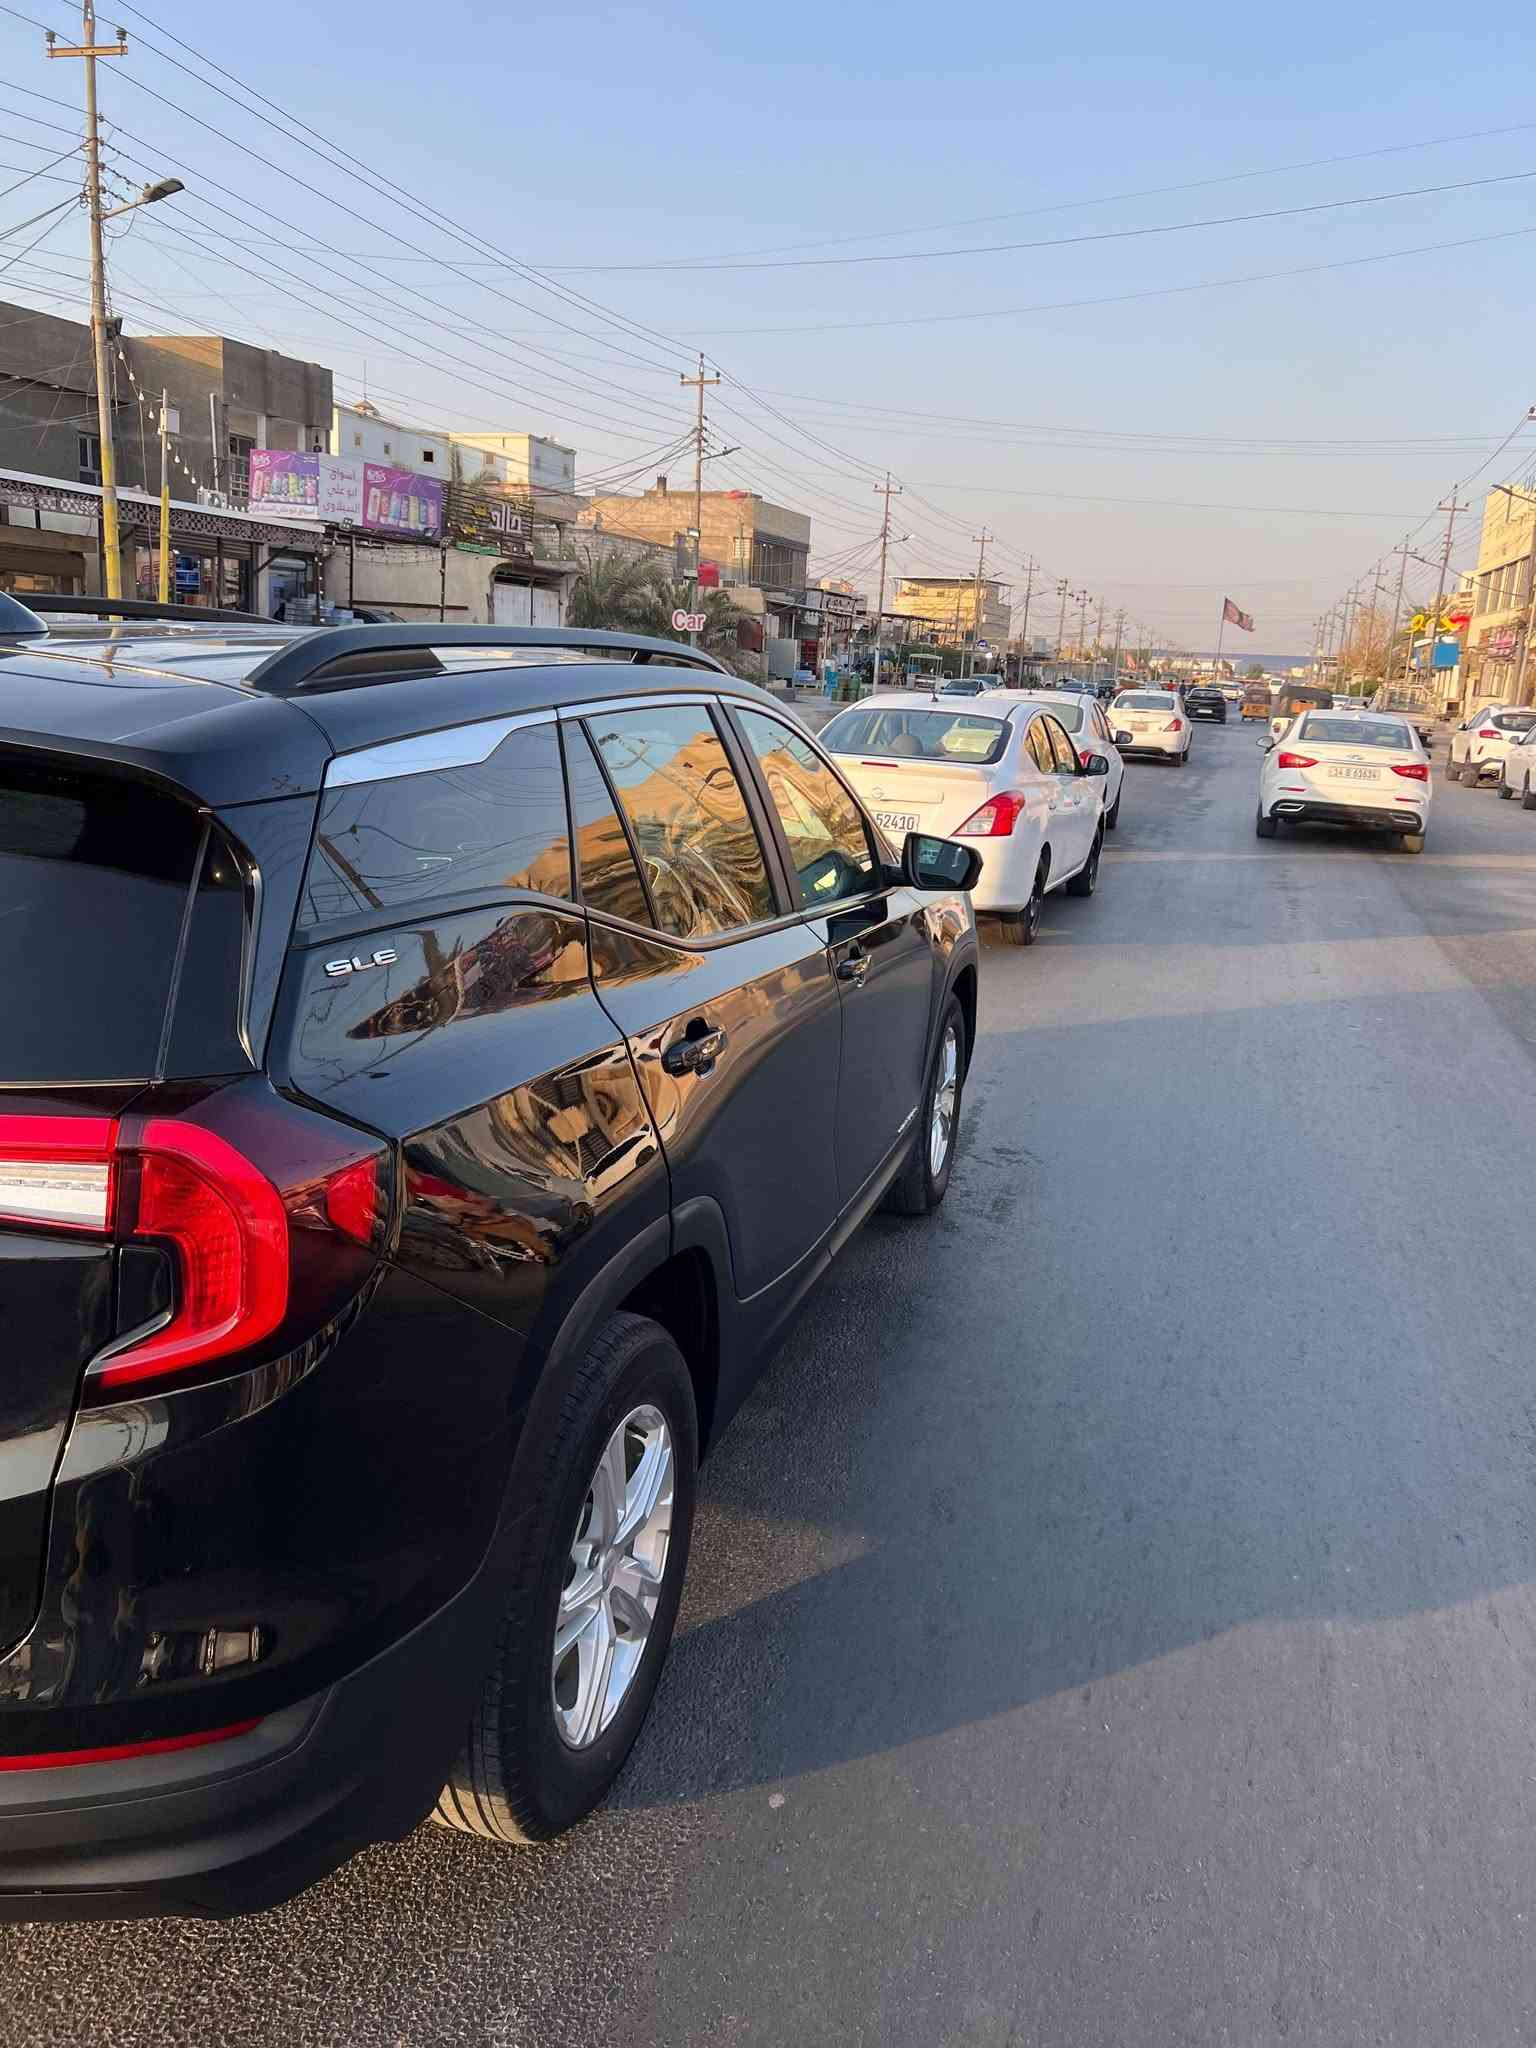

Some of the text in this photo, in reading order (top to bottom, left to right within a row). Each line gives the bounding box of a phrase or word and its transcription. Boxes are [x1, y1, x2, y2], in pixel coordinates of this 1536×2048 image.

[672, 609, 707, 632] Car
[876, 813, 915, 831] 52410
[325, 949, 397, 976] SLE
